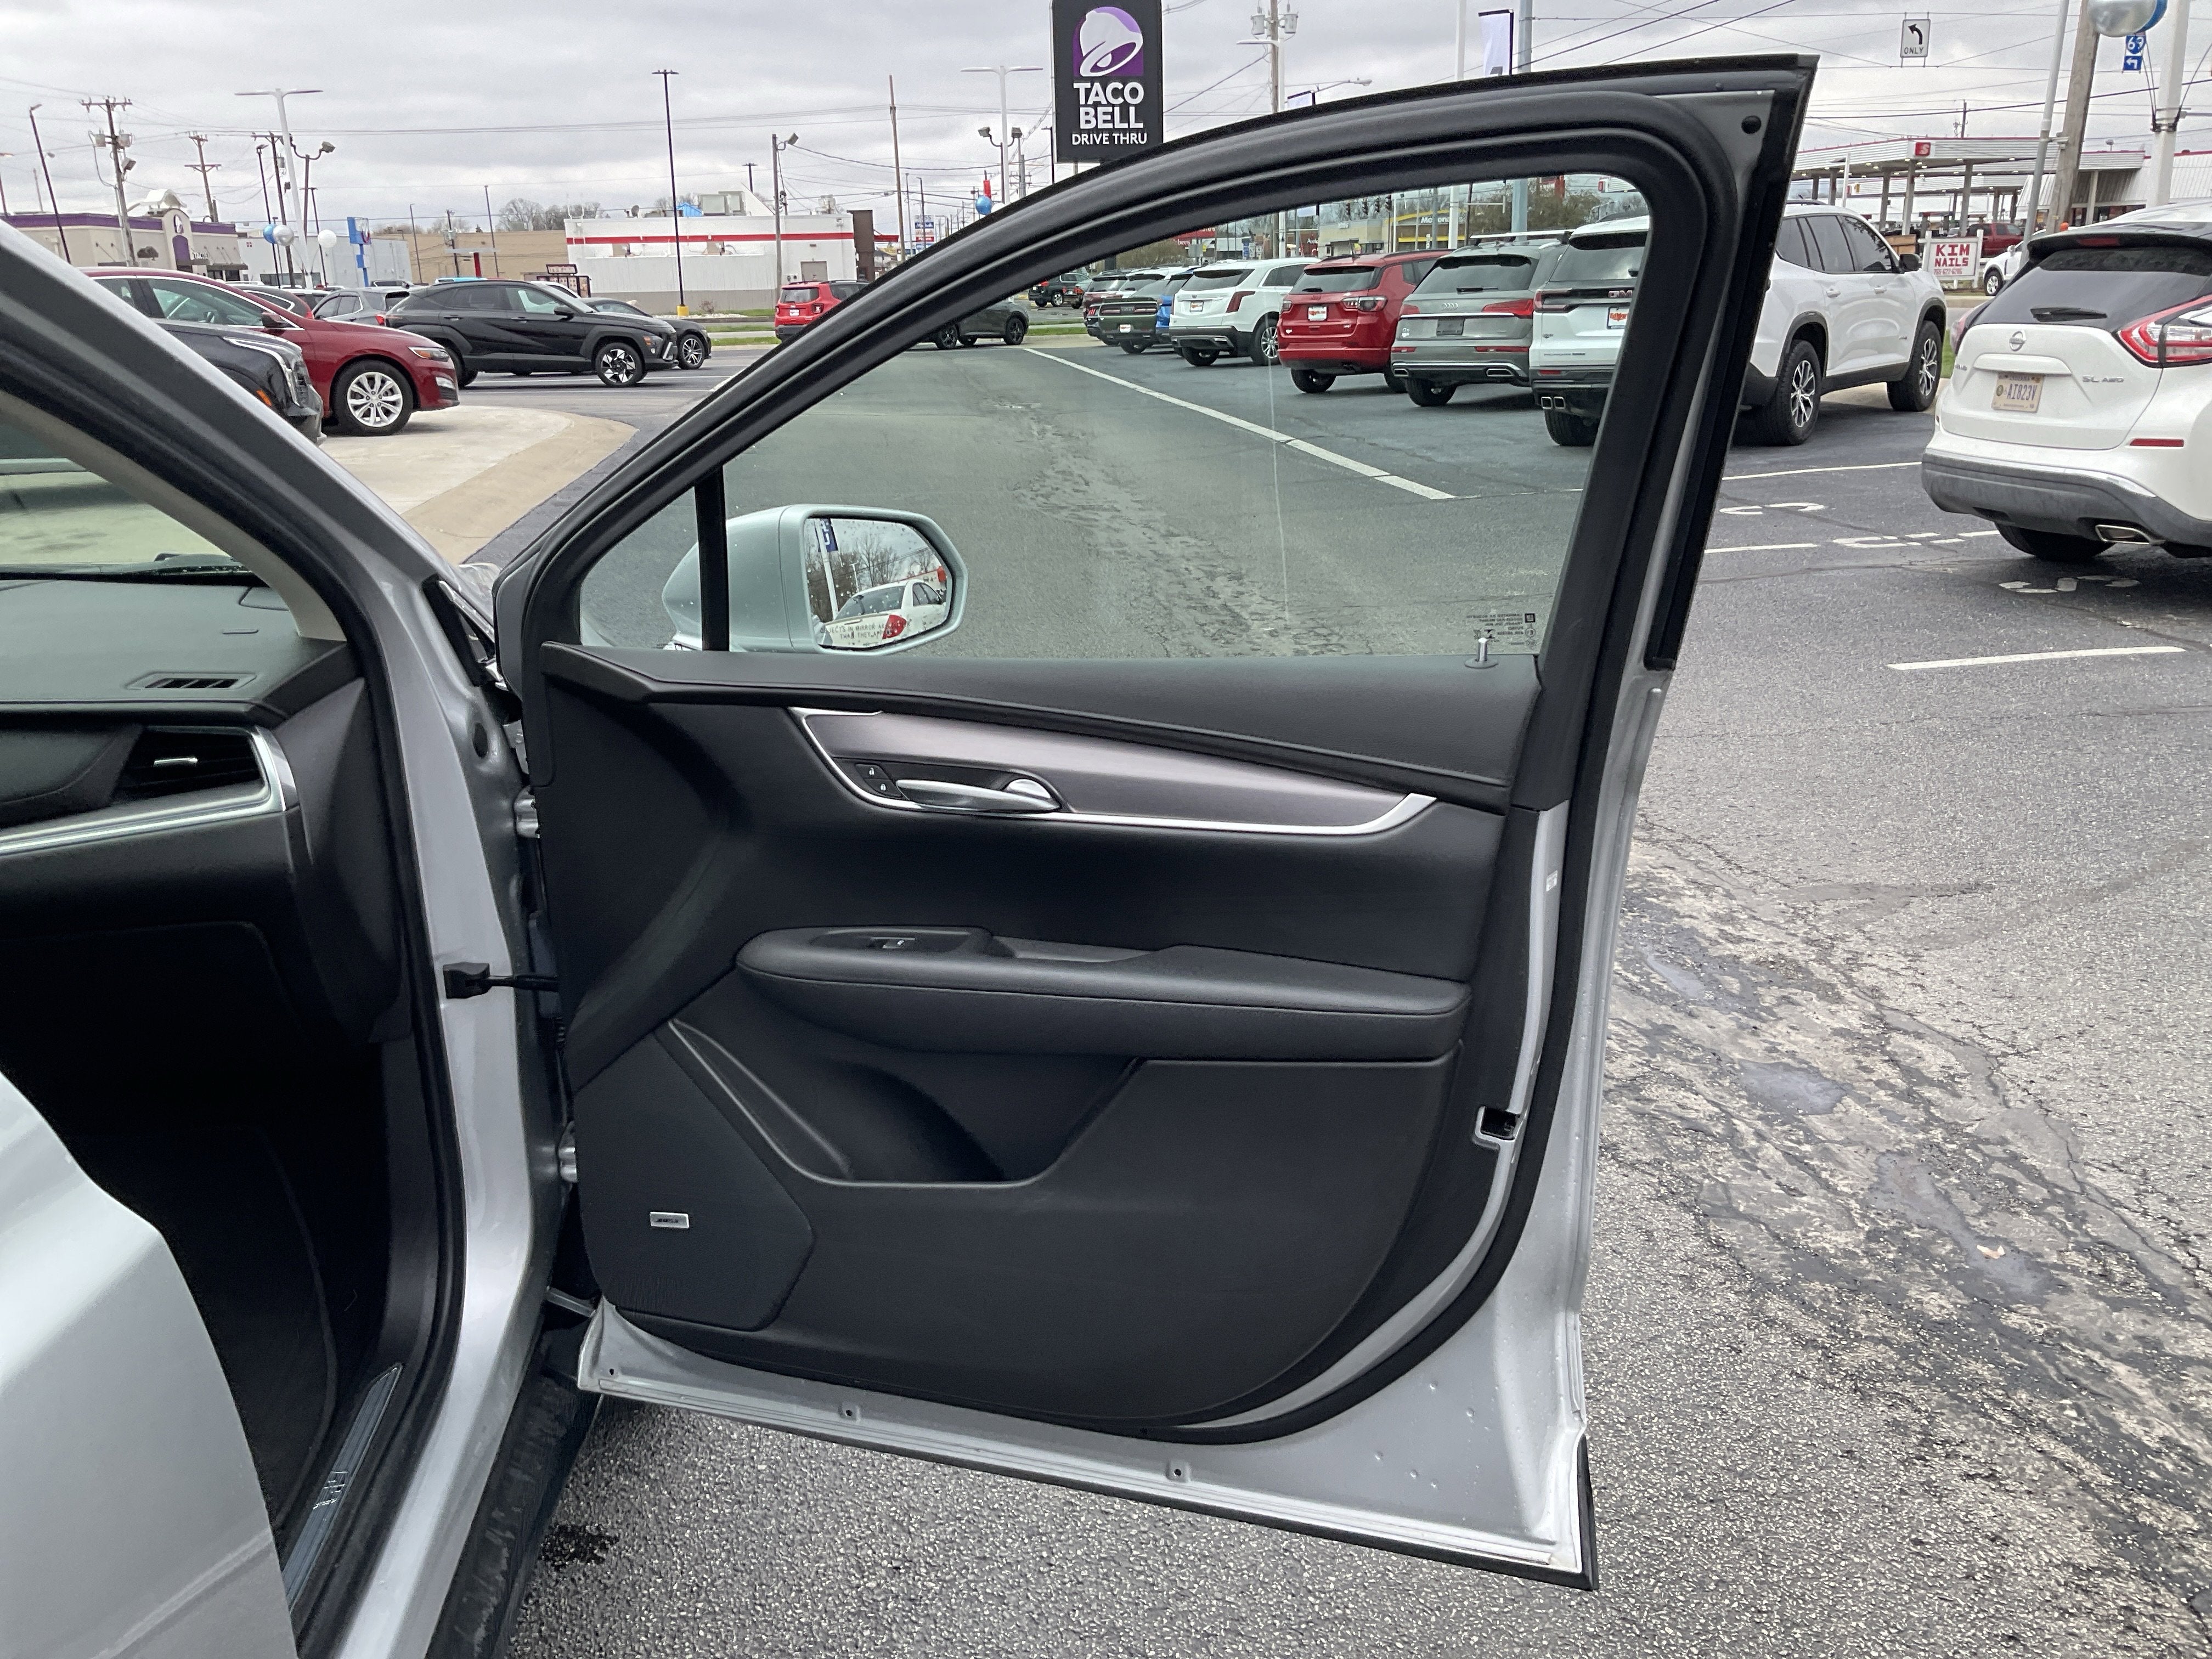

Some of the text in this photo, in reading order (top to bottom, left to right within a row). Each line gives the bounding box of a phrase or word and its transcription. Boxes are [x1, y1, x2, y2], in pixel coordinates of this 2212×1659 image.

[1073, 82, 1144, 105] TACO
[1080, 106, 1144, 129] BELL
[1072, 133, 1147, 145] DRIVE THRU
[1936, 244, 1970, 256] KIM
[1934, 257, 1969, 267] NAILS
[1608, 290, 1633, 298] GM
[2083, 374, 2100, 382] SL
[821, 625, 846, 634] OBJECTS
